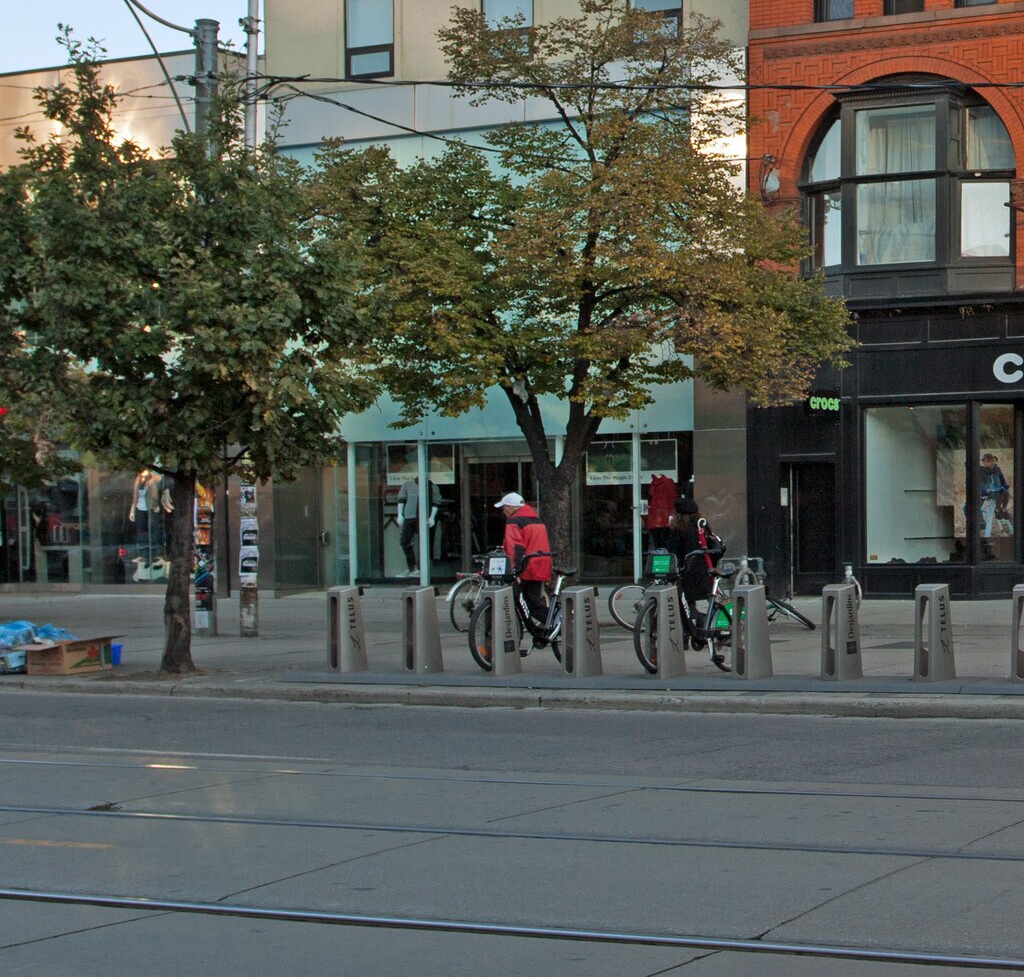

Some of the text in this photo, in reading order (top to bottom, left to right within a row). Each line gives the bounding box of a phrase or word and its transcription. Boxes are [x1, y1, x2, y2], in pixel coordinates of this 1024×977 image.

[810, 396, 840, 411] crocs
[347, 596, 357, 630] TELUS
[502, 595, 512, 639] Desjardins
[584, 597, 593, 632] TELUS
[667, 596, 676, 632] TELUS
[846, 593, 856, 640] Desjardins
[938, 595, 947, 632] TELUS
